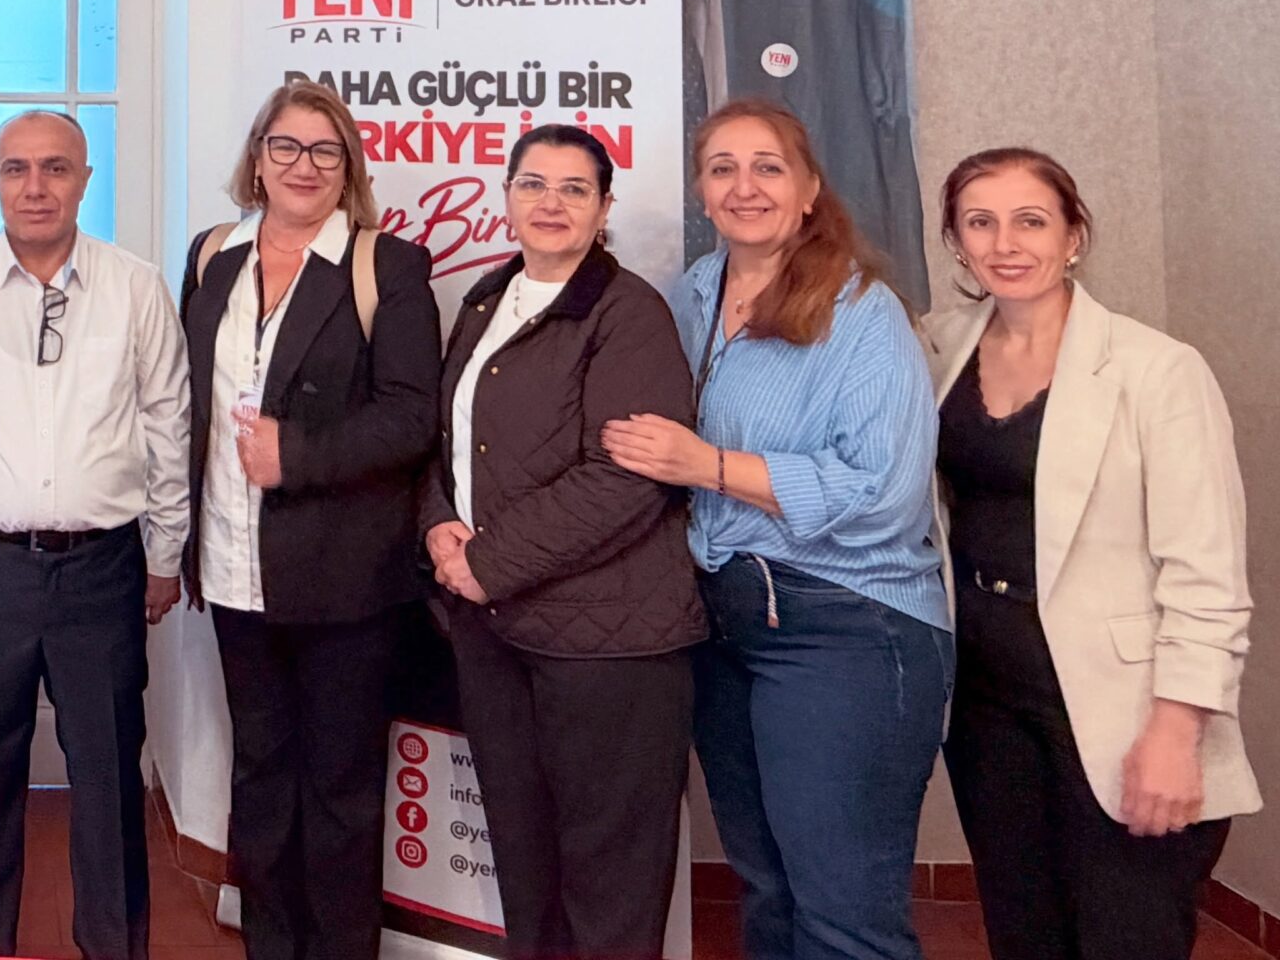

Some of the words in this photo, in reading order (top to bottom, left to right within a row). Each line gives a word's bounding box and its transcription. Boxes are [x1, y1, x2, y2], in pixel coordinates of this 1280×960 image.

[408, 61, 546, 117] GÜÇLÜ
[558, 61, 633, 109] BİR
[353, 109, 506, 165] RKİYE
[450, 784, 483, 806] info
